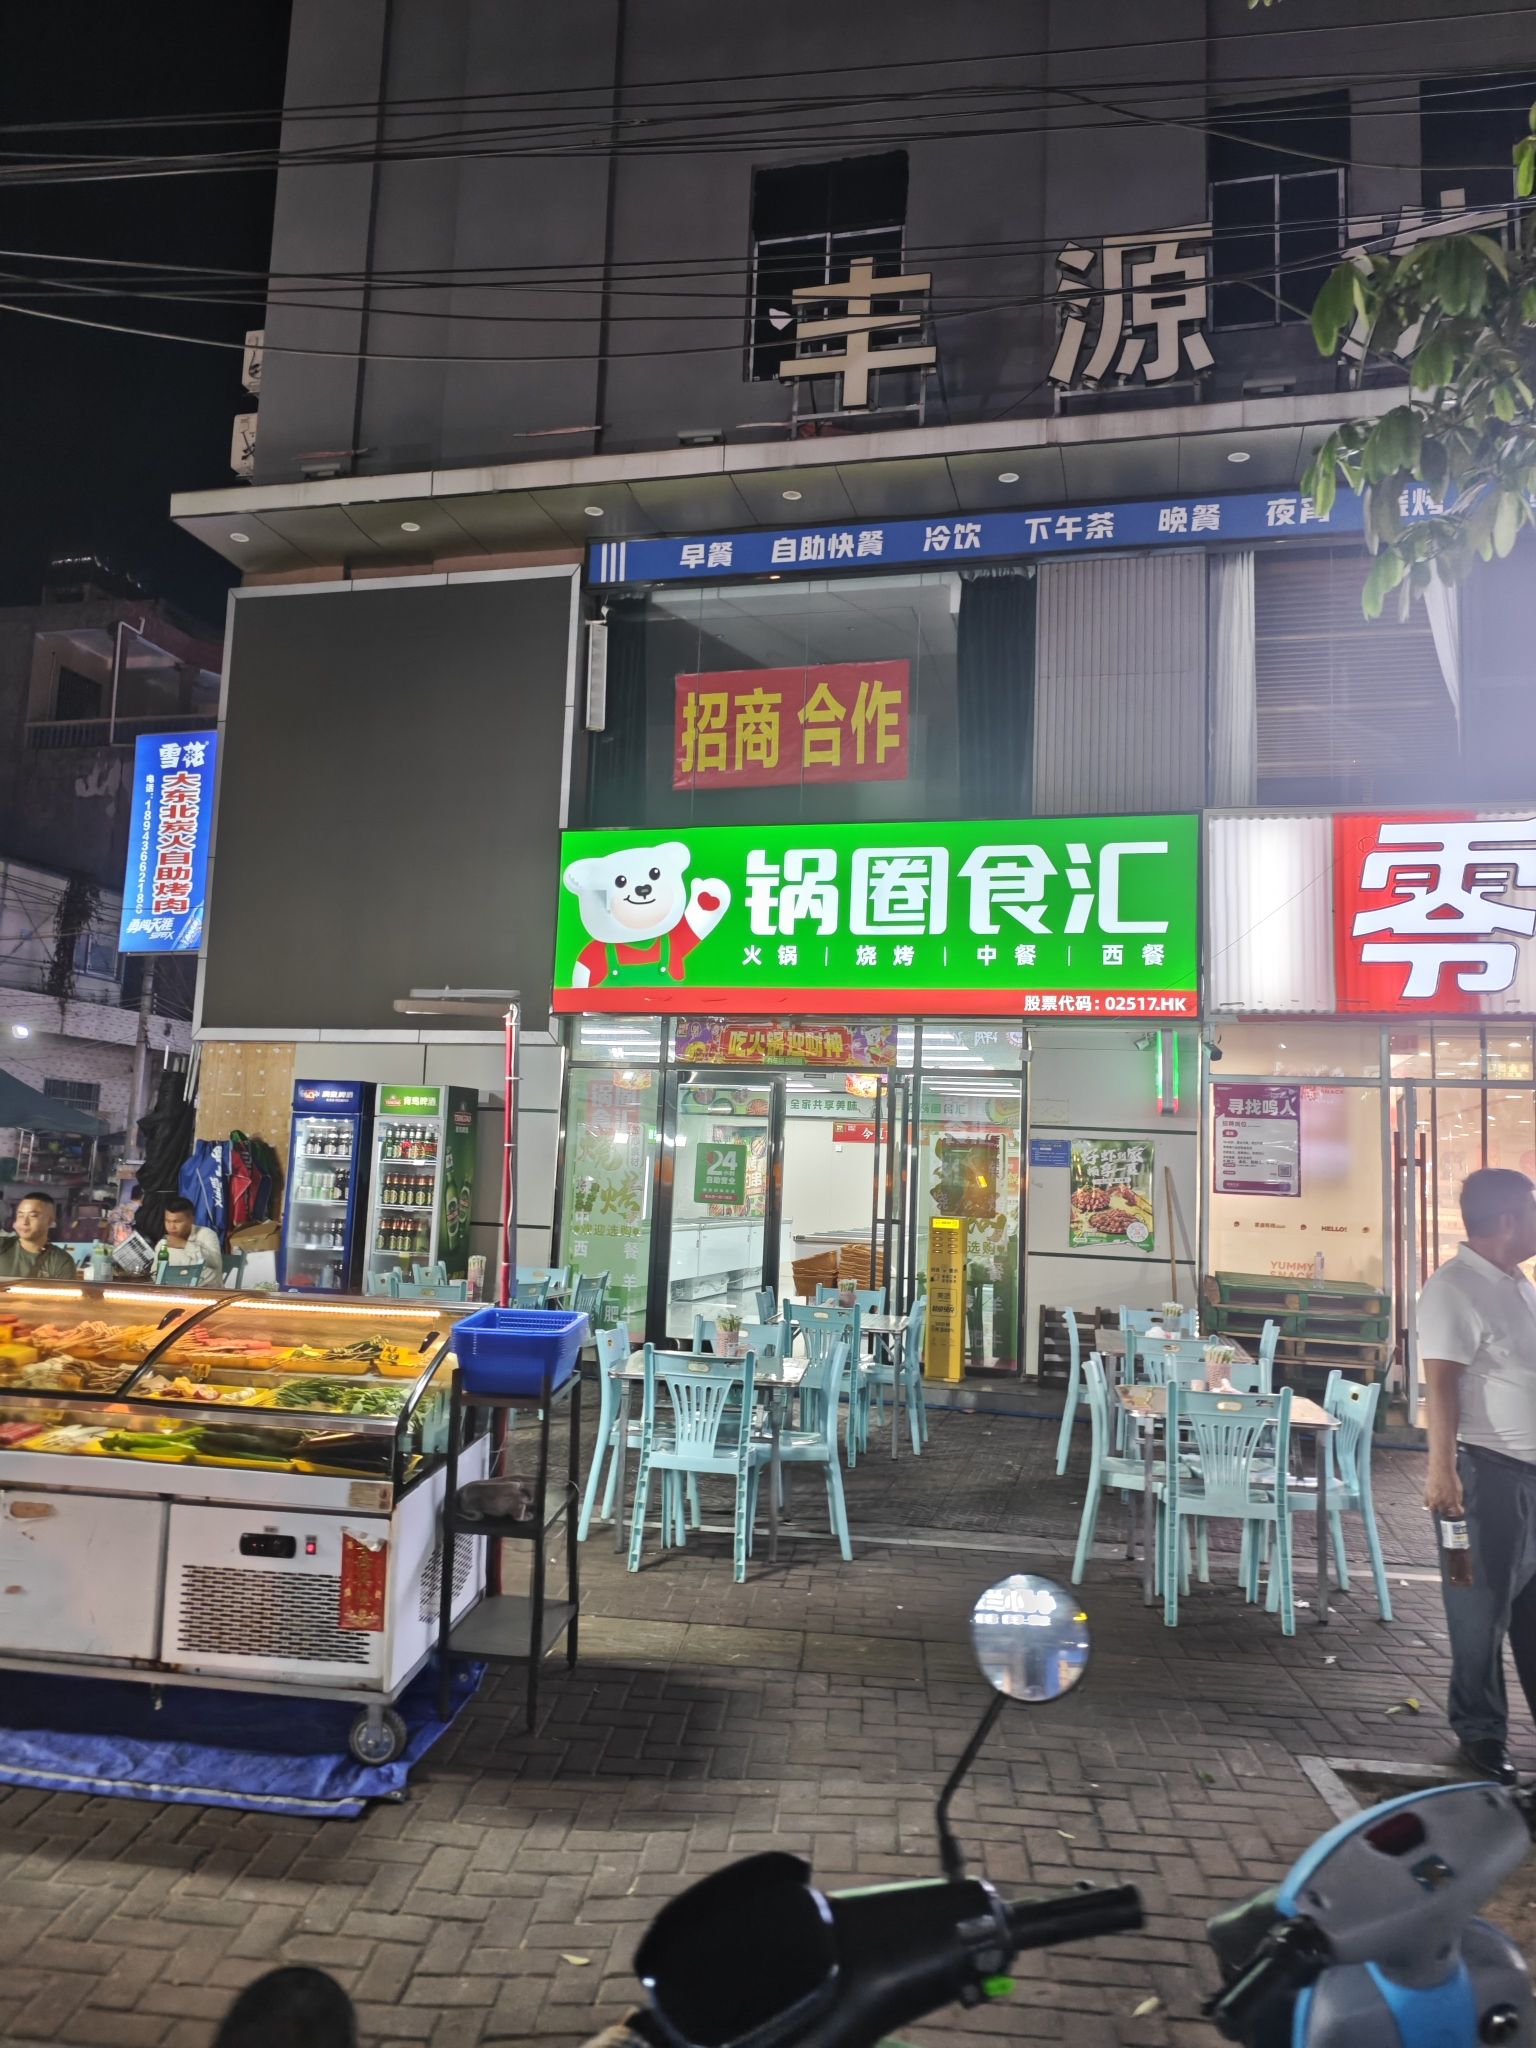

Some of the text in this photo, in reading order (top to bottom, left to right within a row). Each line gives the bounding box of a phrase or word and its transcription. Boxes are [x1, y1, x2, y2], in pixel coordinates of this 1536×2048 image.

[679, 542, 734, 569] 早餐
[770, 530, 884, 564] 自助快餐
[923, 522, 982, 552] 冷饮
[1024, 512, 1115, 545] 下午茶
[1158, 504, 1221, 534] 晚餐
[681, 680, 902, 772] 招商合作
[159, 741, 206, 769] 雪花
[151, 770, 202, 915] 大东北炭火自助烤肉
[745, 840, 1169, 938] 锅圈食汇
[1352, 817, 1536, 999] 零
[741, 943, 1165, 967] 火锅 烧烤 中餐 西餐
[789, 1099, 858, 1111] 全家共享美味
[706, 1150, 738, 1176] 24
[1270, 1261, 1314, 1273] YUMMY
